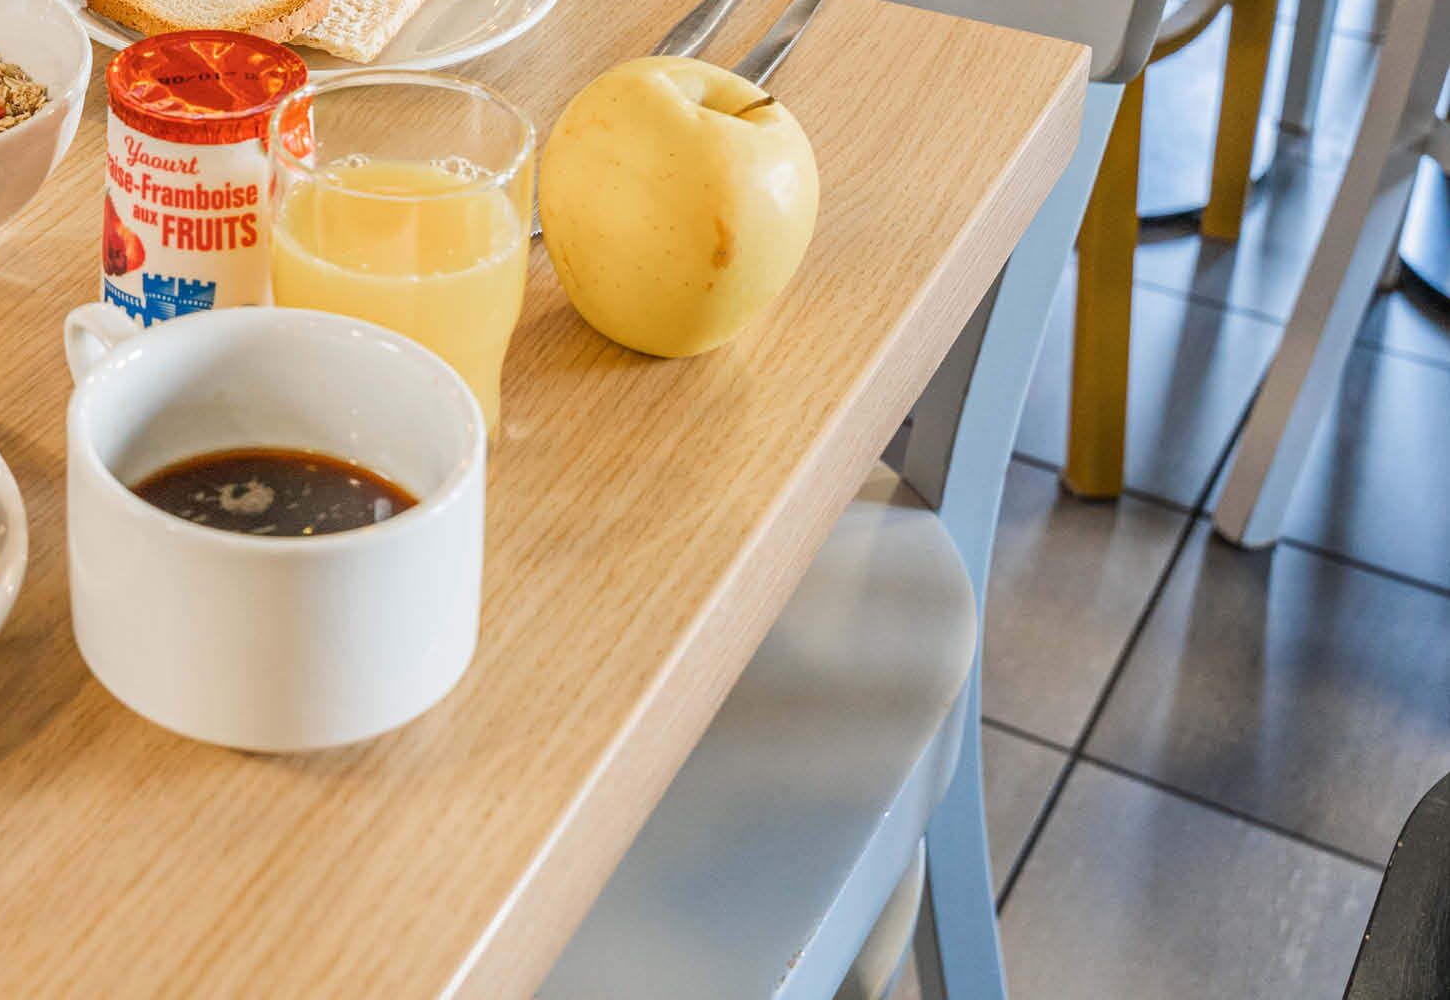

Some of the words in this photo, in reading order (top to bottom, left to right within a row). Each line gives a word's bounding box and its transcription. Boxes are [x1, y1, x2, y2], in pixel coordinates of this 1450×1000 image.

[124, 135, 198, 175] Yaourt
[133, 203, 158, 226] aux
[161, 213, 258, 252] FRUITS
